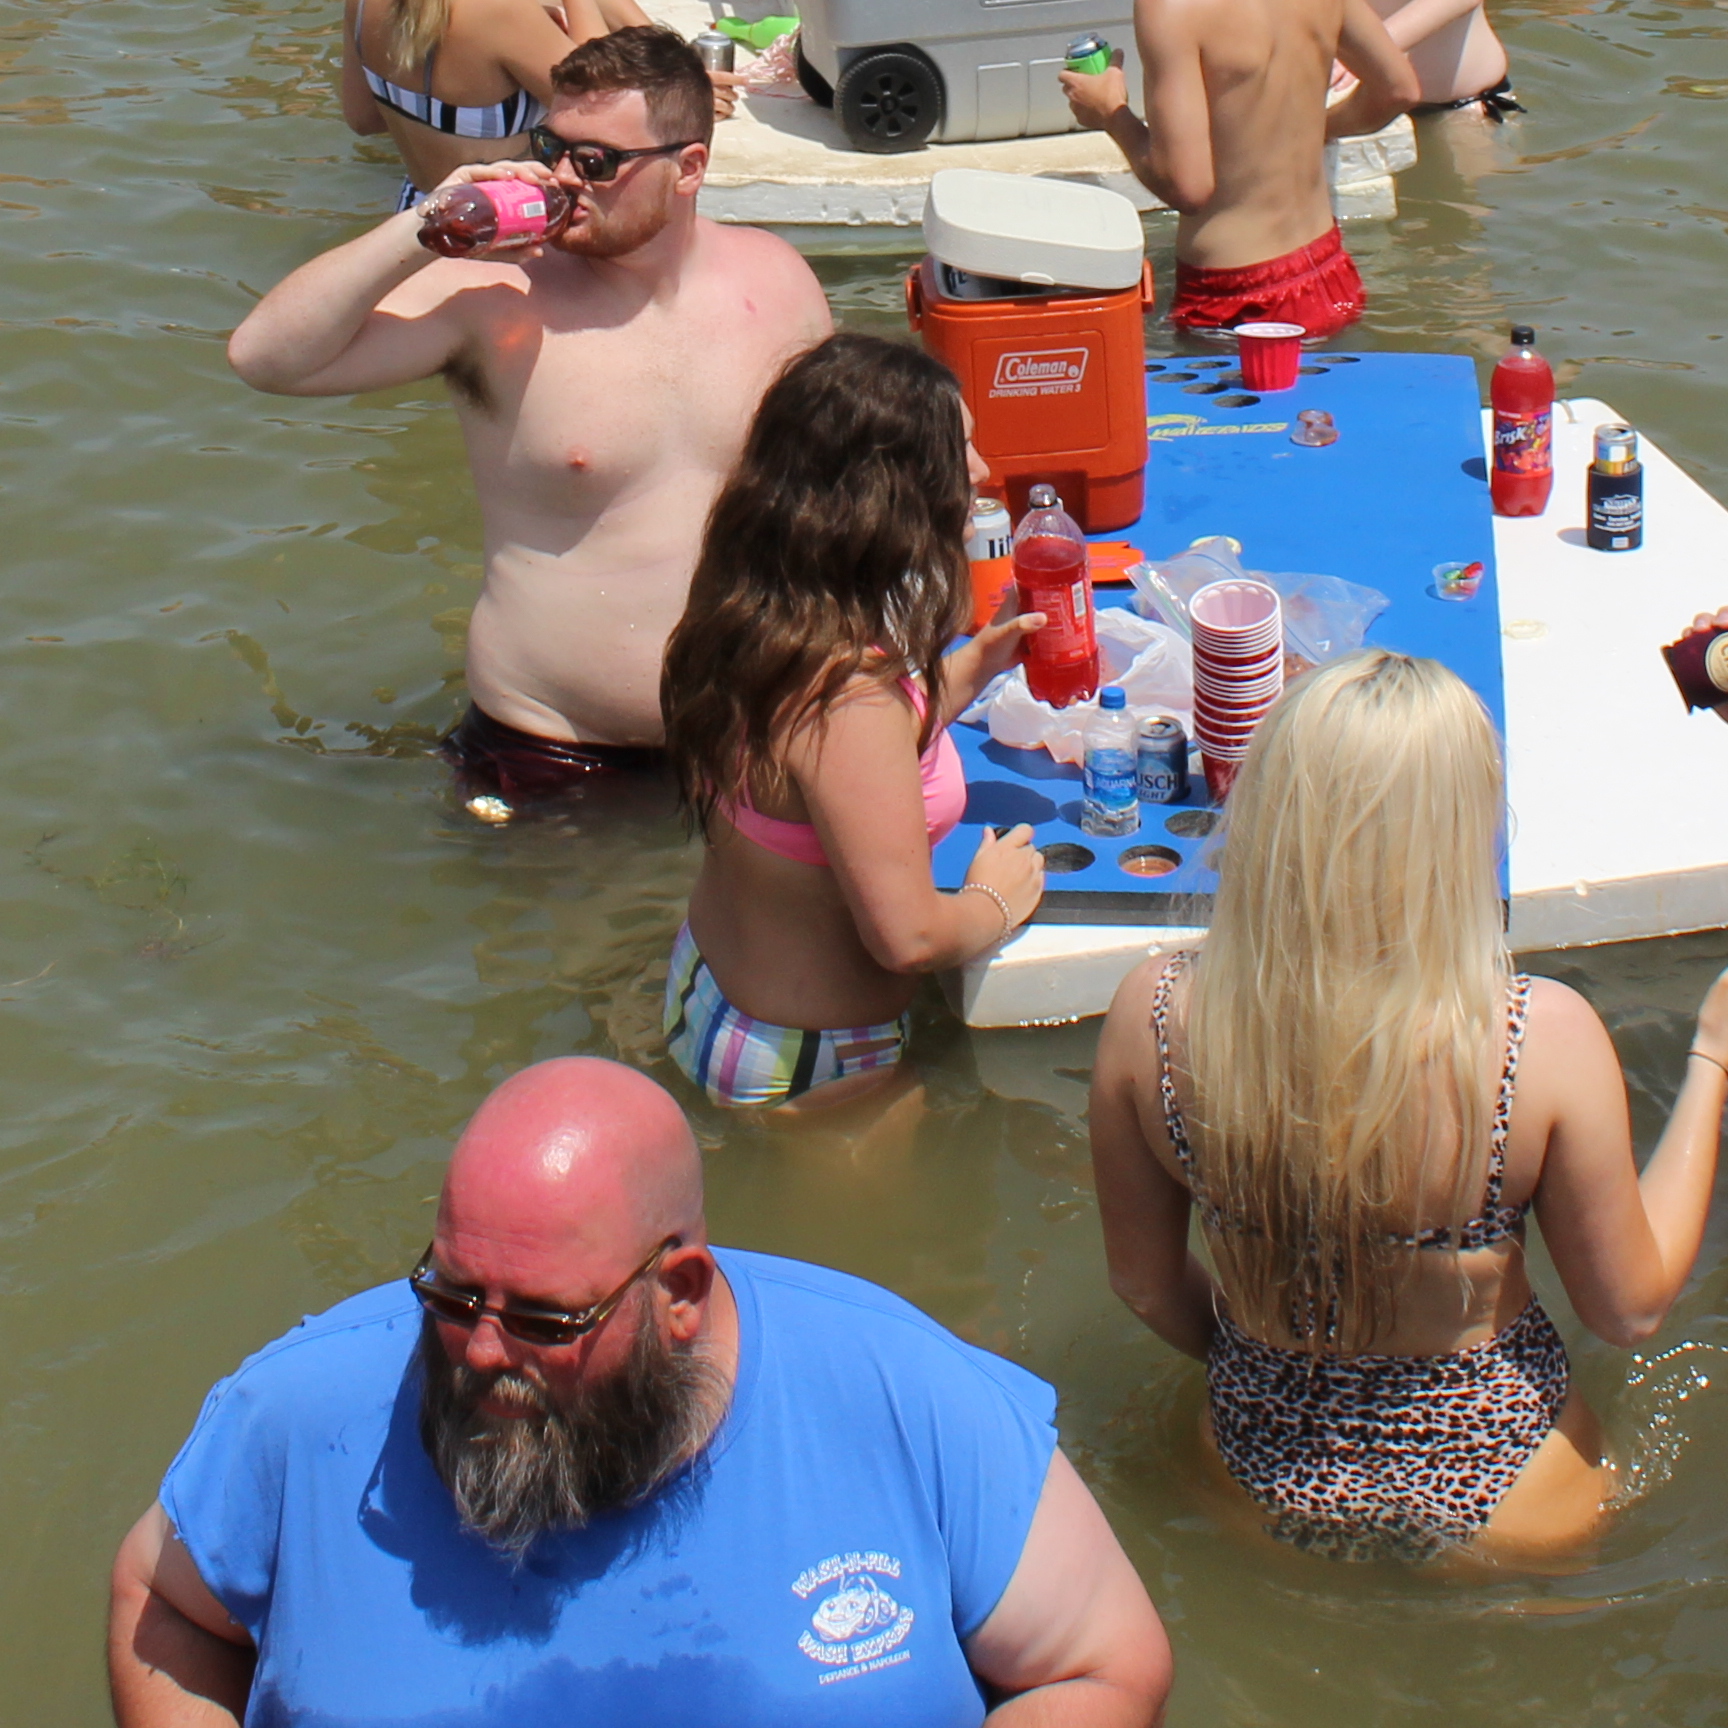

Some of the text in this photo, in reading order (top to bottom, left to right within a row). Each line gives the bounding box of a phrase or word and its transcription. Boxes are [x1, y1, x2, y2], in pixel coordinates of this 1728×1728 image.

[1004, 356, 1068, 382] Coleman
[988, 386, 1039, 399] DRINKING
[1040, 384, 1074, 396] WATER
[1136, 773, 1179, 791] USCH
[1138, 789, 1166, 800] IGHT
[798, 1604, 915, 1665] WASH EXPRESS
[869, 1649, 912, 1674] NAPOLEON
